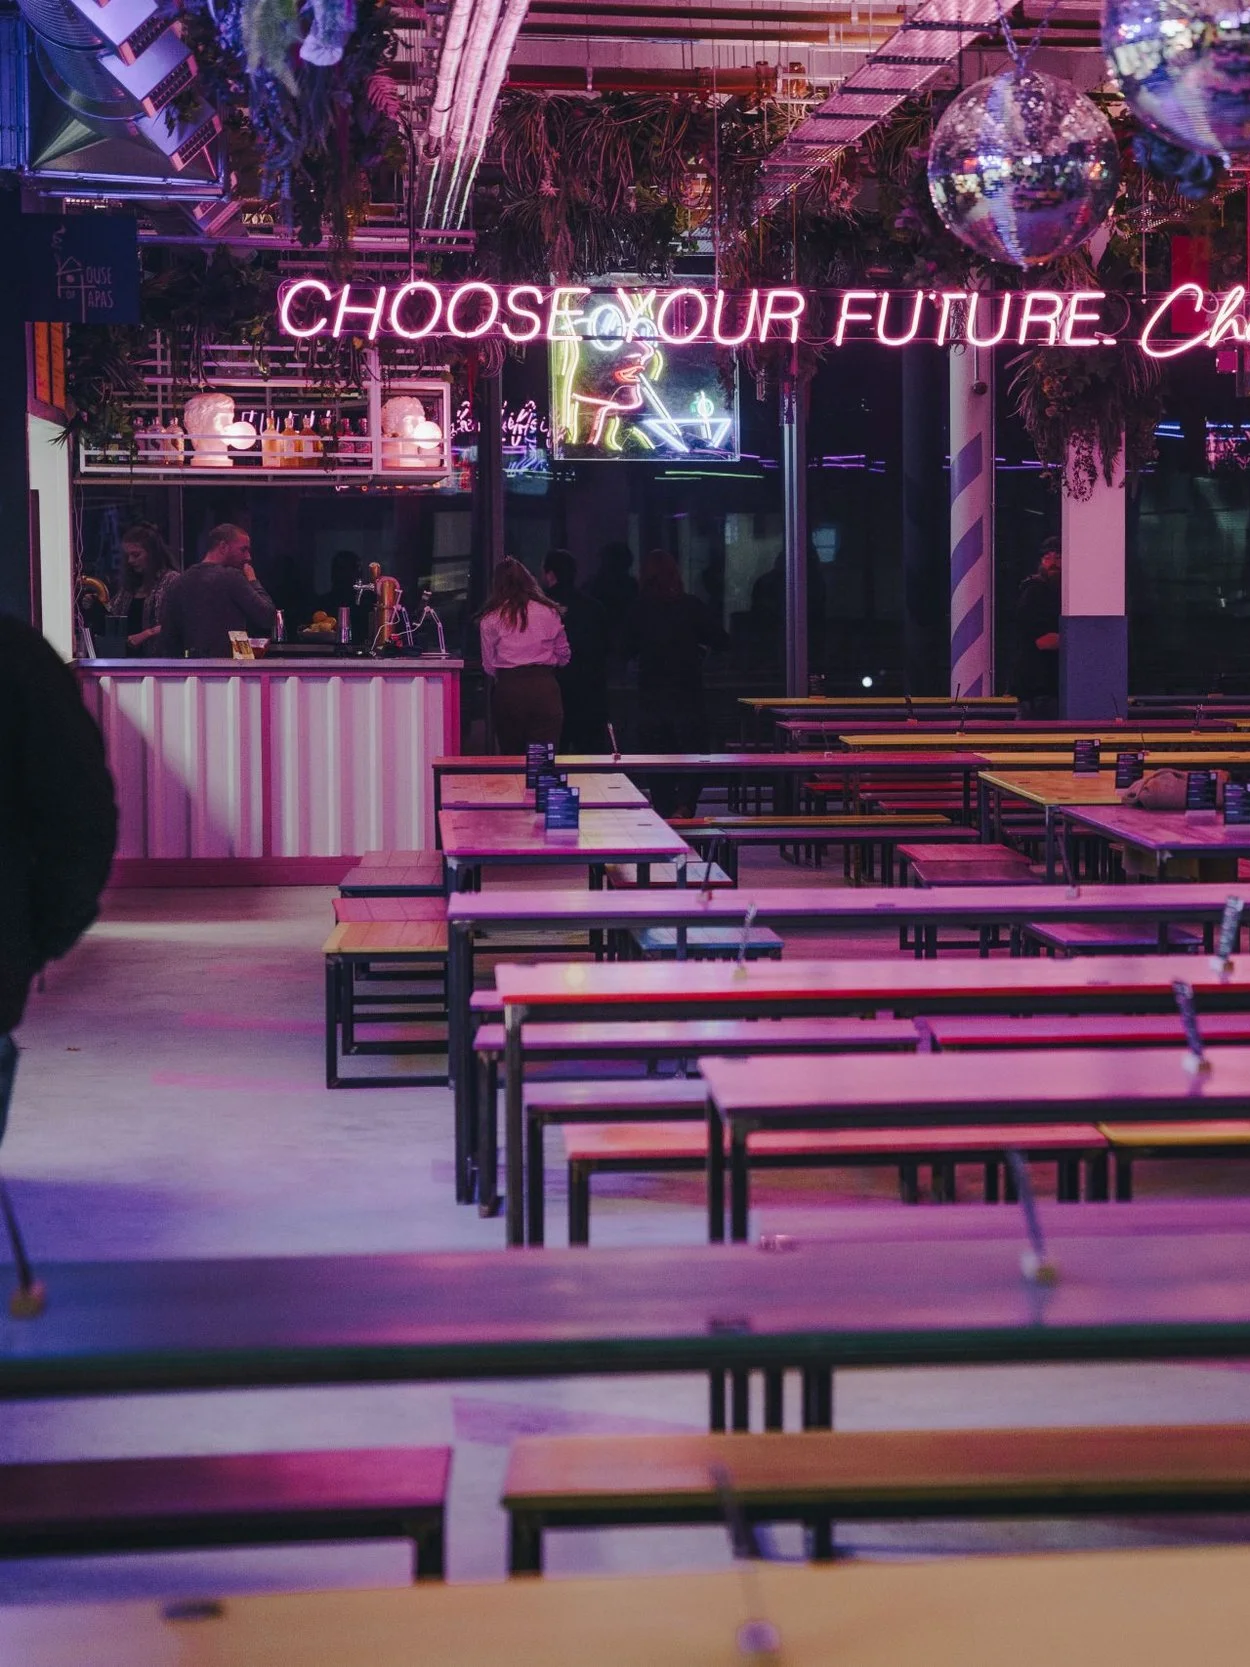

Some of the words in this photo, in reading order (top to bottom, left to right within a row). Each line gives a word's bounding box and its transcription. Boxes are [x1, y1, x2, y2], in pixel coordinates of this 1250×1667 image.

[281, 278, 592, 342] CHOOSE
[616, 287, 806, 346] YOUR
[834, 290, 1118, 347] FUTURE.
